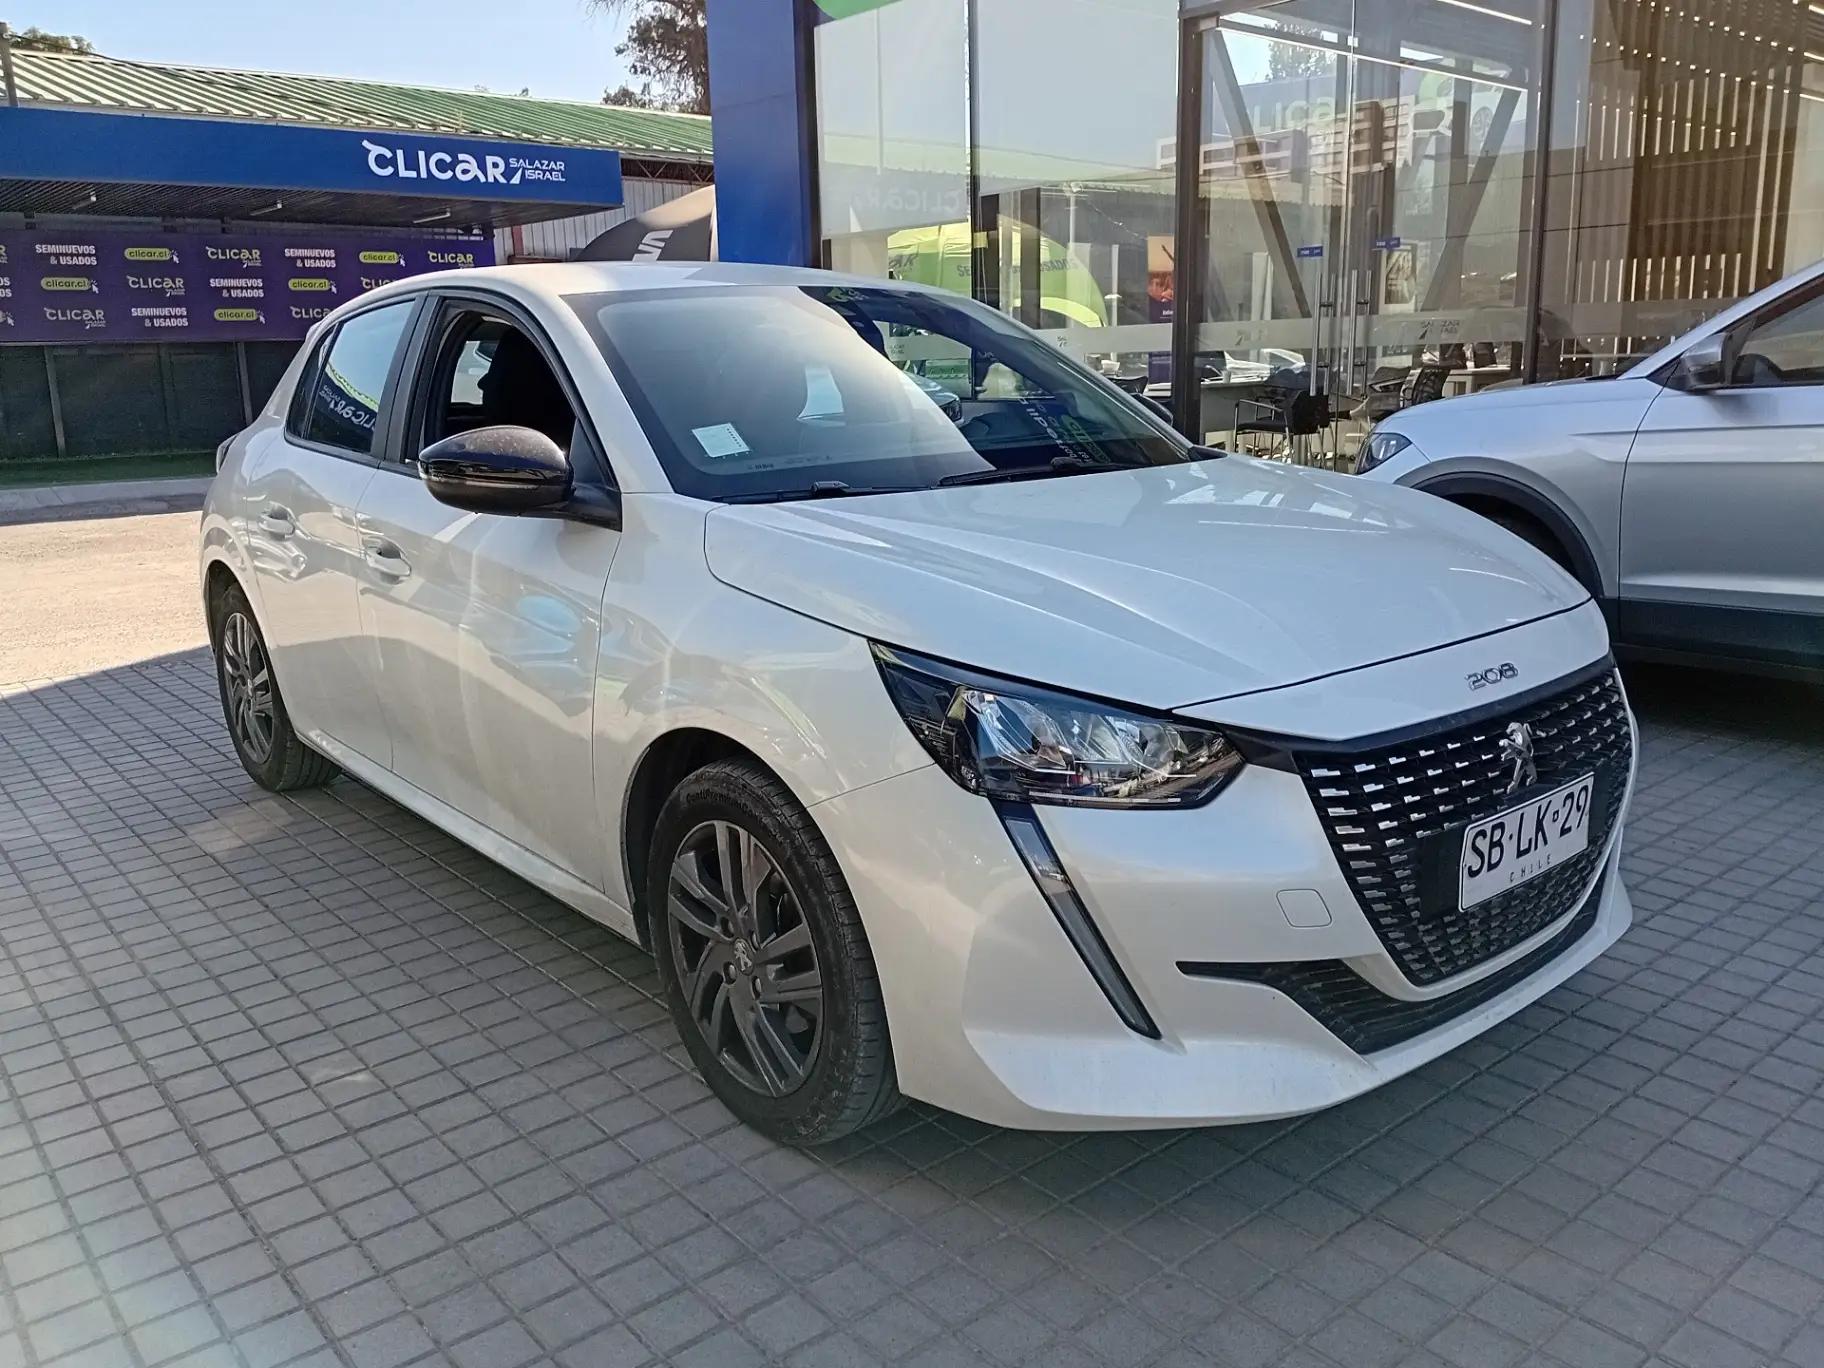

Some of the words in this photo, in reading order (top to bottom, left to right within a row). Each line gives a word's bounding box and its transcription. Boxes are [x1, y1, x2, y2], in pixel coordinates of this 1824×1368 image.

[509, 157, 565, 172] SALAZAR
[525, 170, 566, 182] ISRAEL
[35, 244, 96, 254] SEMINUEVOS
[129, 248, 167, 257] clicar.cl
[284, 248, 335, 258] SEMINUEVOS
[50, 256, 58, 265] &
[60, 256, 97, 266] USADOS
[363, 253, 396, 261] clicar.cl
[296, 259, 303, 268] &
[304, 259, 336, 268] USADOS
[45, 279, 87, 288] clicar.cl
[209, 278, 263, 288] SEMINUEVOS
[292, 280, 327, 288] clicar.cl
[222, 289, 229, 298] &
[231, 289, 265, 298] USADOS
[131, 307, 187, 317] SEMINUEVOS
[218, 309, 254, 318] clicar.cl
[144, 318, 152, 327] &
[154, 318, 188, 327] USADOS
[1465, 662, 1519, 690] 208
[1509, 853, 1553, 883] CHILE
